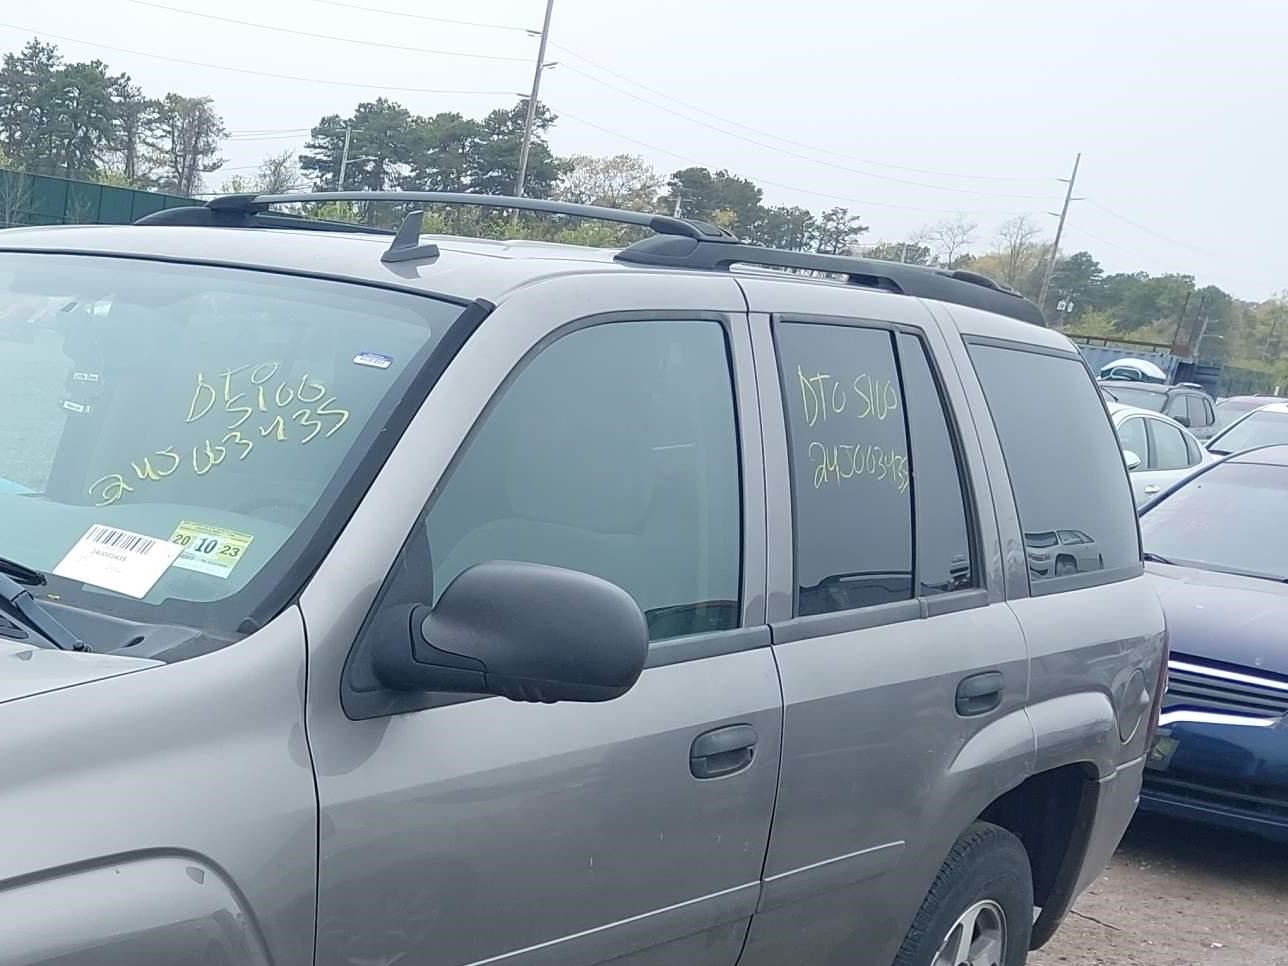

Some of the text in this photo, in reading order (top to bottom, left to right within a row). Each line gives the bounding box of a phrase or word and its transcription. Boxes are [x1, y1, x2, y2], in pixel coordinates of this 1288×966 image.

[172, 534, 240, 557] 20 10 23
